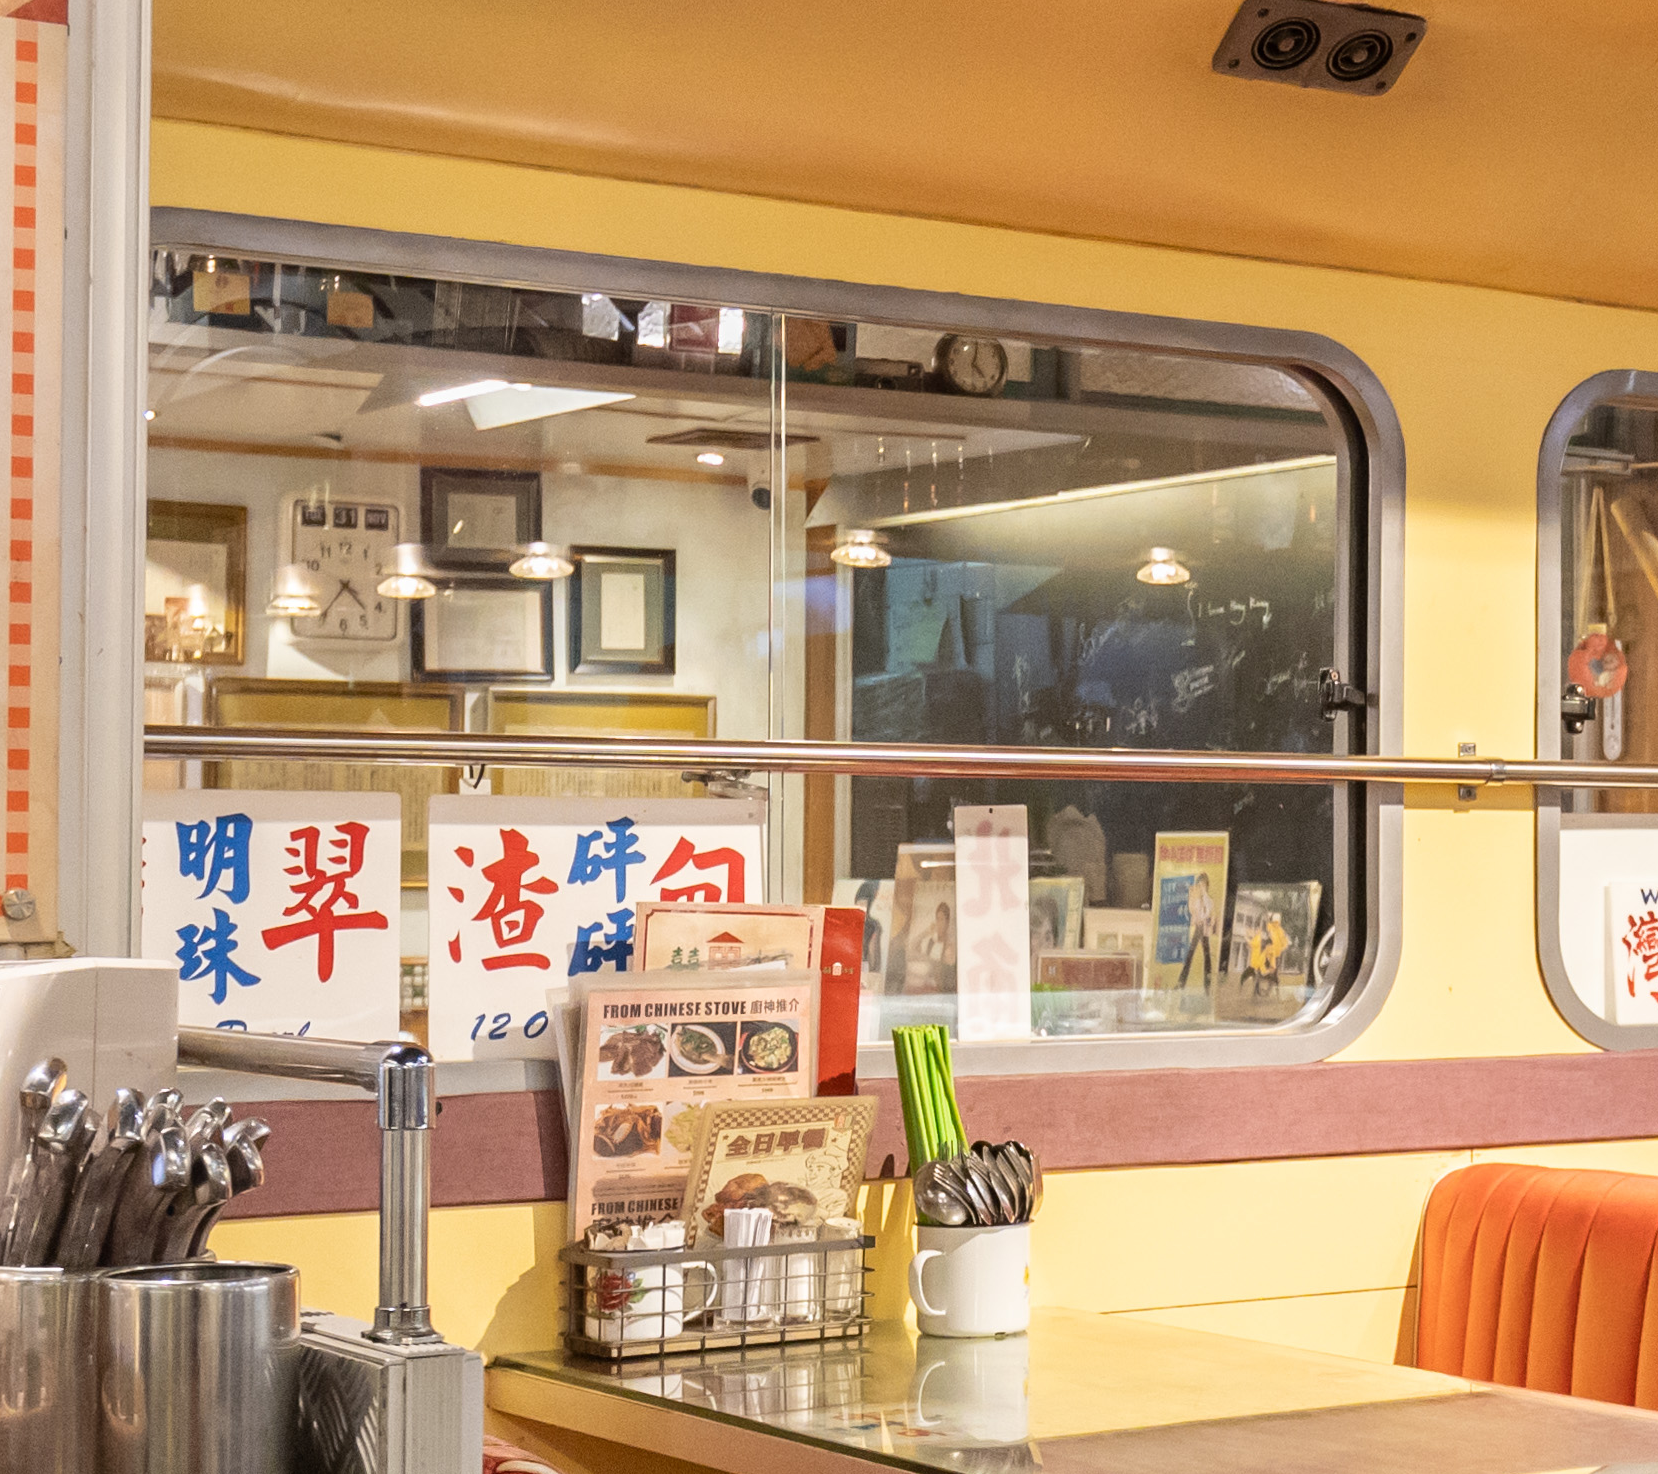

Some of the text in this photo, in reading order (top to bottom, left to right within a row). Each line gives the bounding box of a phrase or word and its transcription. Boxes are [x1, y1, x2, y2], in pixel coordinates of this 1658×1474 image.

[175, 812, 262, 1006] 明珠
[260, 821, 389, 984] 翠
[603, 1004, 641, 1019] FROM
[644, 1002, 701, 1017] CHINESE
[704, 1000, 747, 1016] STOVE
[591, 1197, 679, 1216] FROM CHINESE
